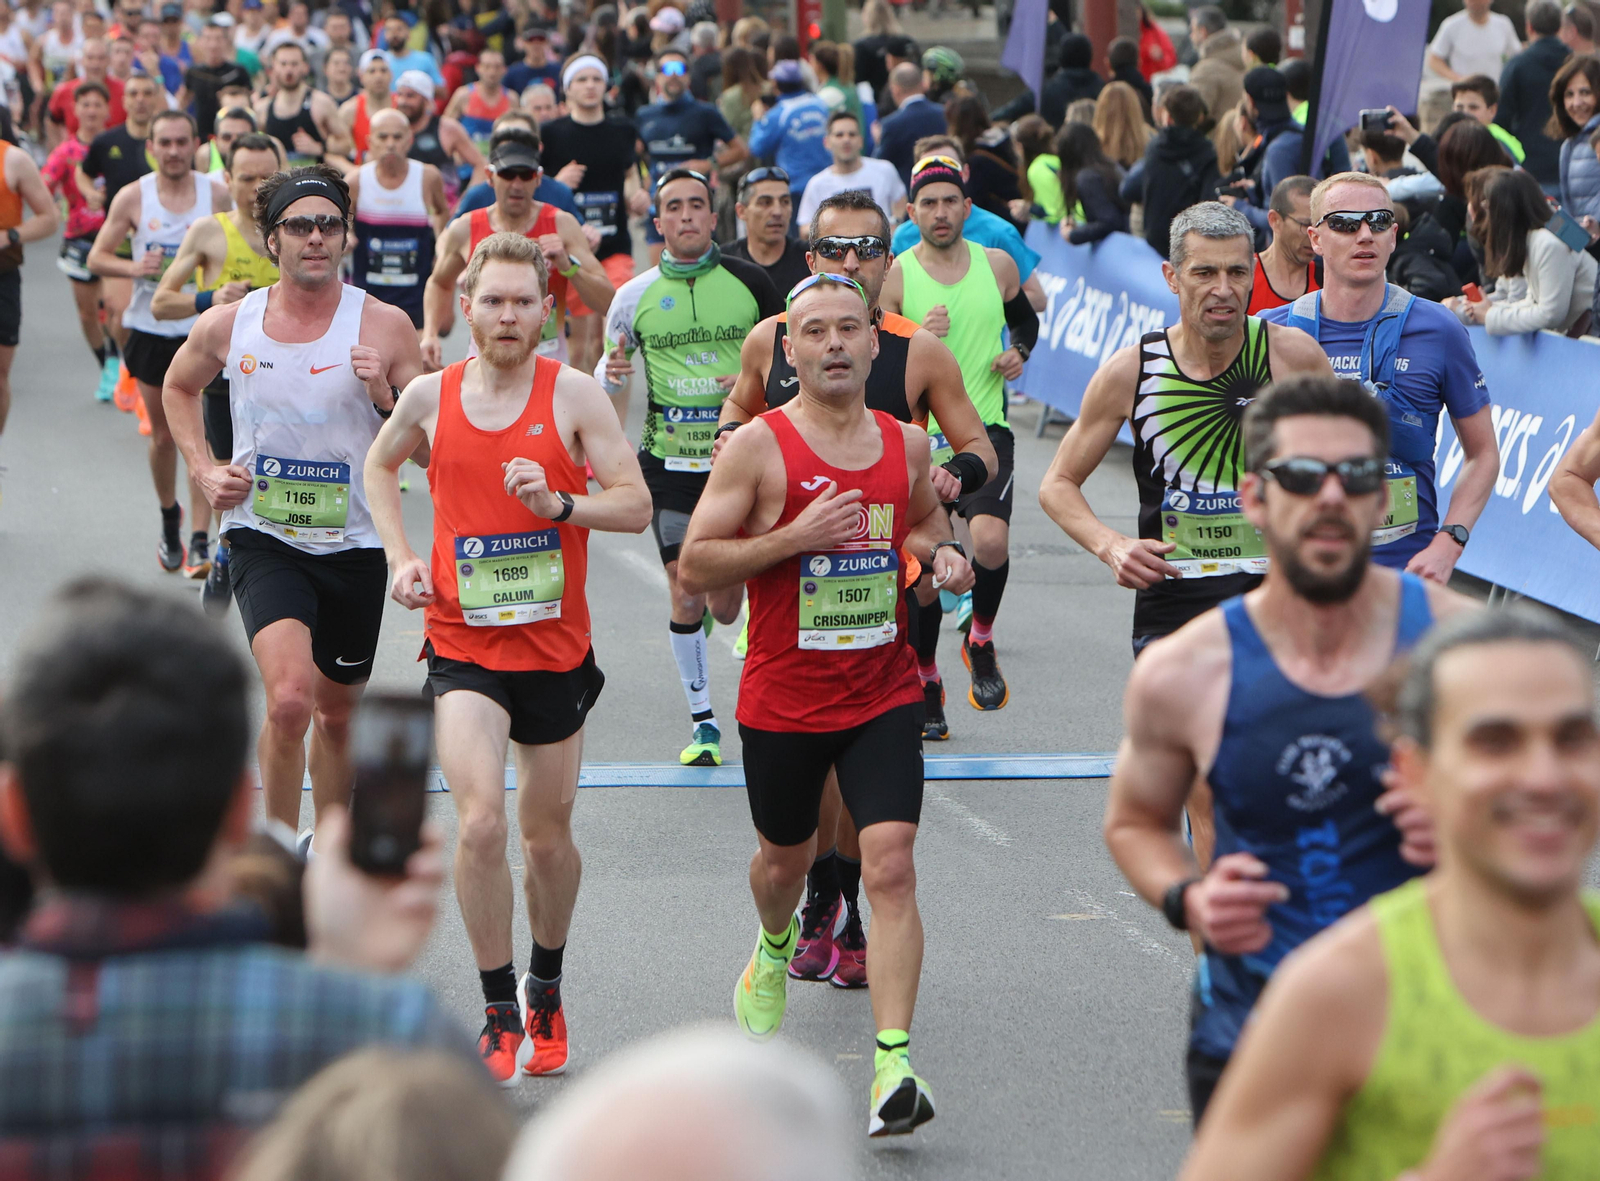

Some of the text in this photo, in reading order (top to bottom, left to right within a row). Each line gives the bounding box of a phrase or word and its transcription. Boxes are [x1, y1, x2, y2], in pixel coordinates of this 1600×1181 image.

[650, 326, 712, 349] Malpartida
[259, 361, 274, 369] NN
[685, 351, 719, 366] ALEX
[667, 377, 718, 389] VICTOR
[677, 387, 729, 397] ENDURAN
[686, 410, 719, 419] ZURIC
[687, 430, 711, 441] 1839
[286, 465, 339, 479] ZURICH
[285, 490, 316, 505] 1165
[1195, 497, 1243, 511] ZURIC
[285, 513, 312, 525] JOSE
[1196, 525, 1232, 539] 1150
[491, 535, 549, 551] ZURICH
[1191, 546, 1242, 558] MACEDO
[493, 566, 529, 582] 1689
[493, 589, 534, 603] CALUM
[837, 588, 871, 603] 1507
[813, 610, 888, 627] CRISDANIPEPI
